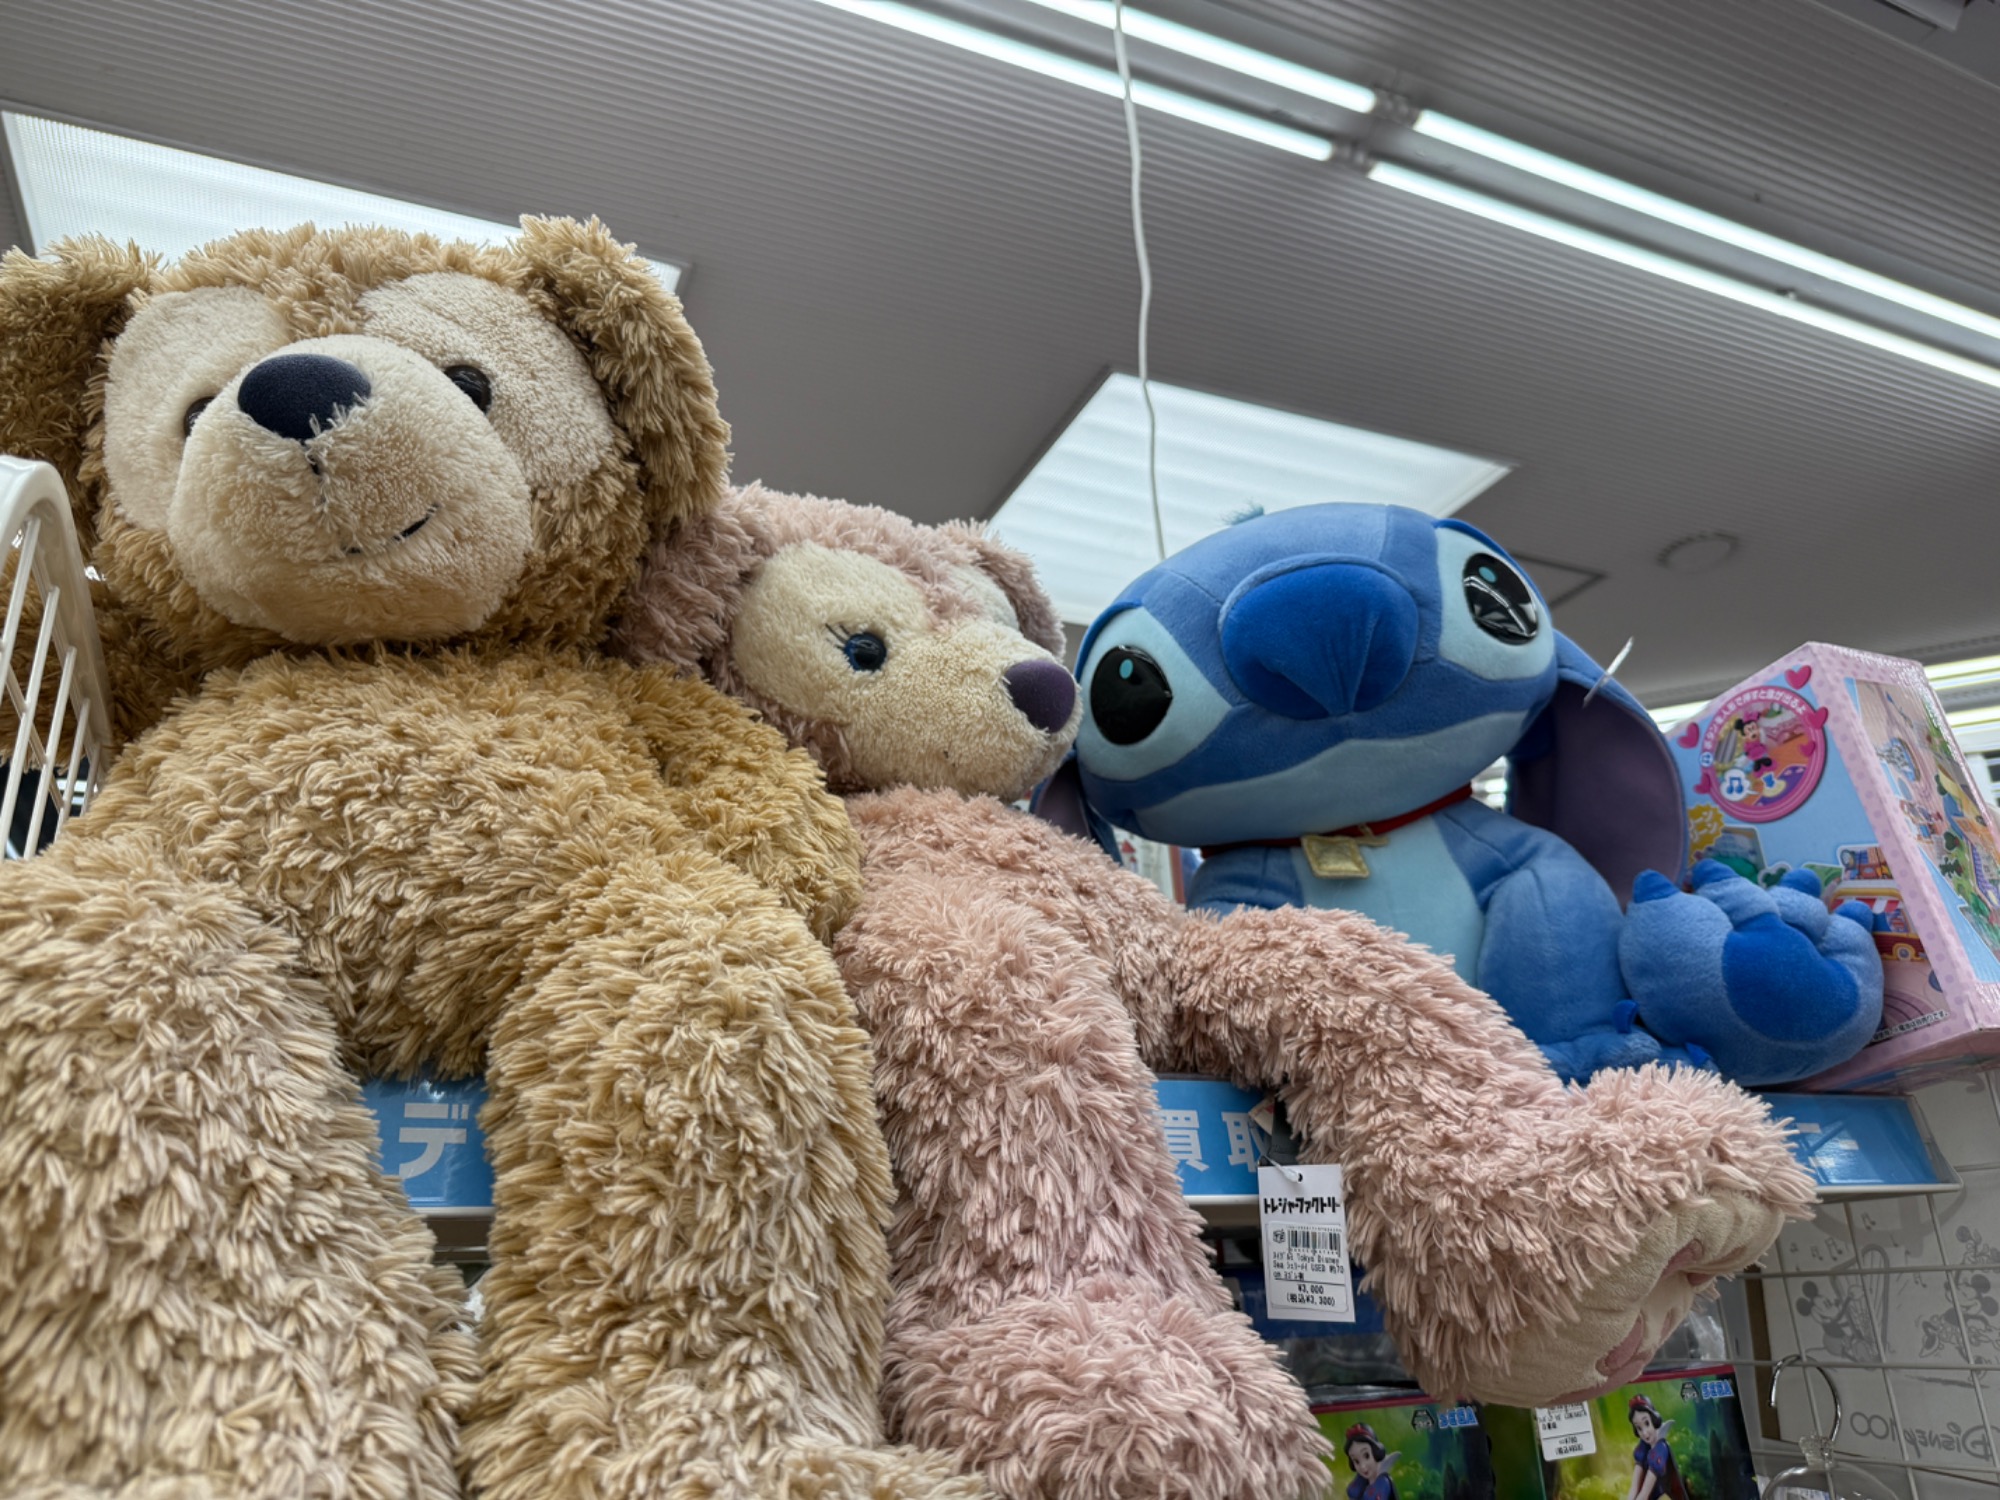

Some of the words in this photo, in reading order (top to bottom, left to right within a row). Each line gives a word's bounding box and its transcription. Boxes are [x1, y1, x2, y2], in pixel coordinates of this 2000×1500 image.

[399, 1103, 470, 1180] デ
[1264, 1196, 1341, 1214] トレジャーファクトリー
[1297, 1252, 1315, 1263] Tokyo
[1318, 1254, 1340, 1266] Disney
[1311, 1263, 1326, 1272] USED
[1298, 1284, 1324, 1294] ¥3,000
[1701, 1379, 1735, 1400] SEGA
[1438, 1406, 1479, 1429] SEGA
